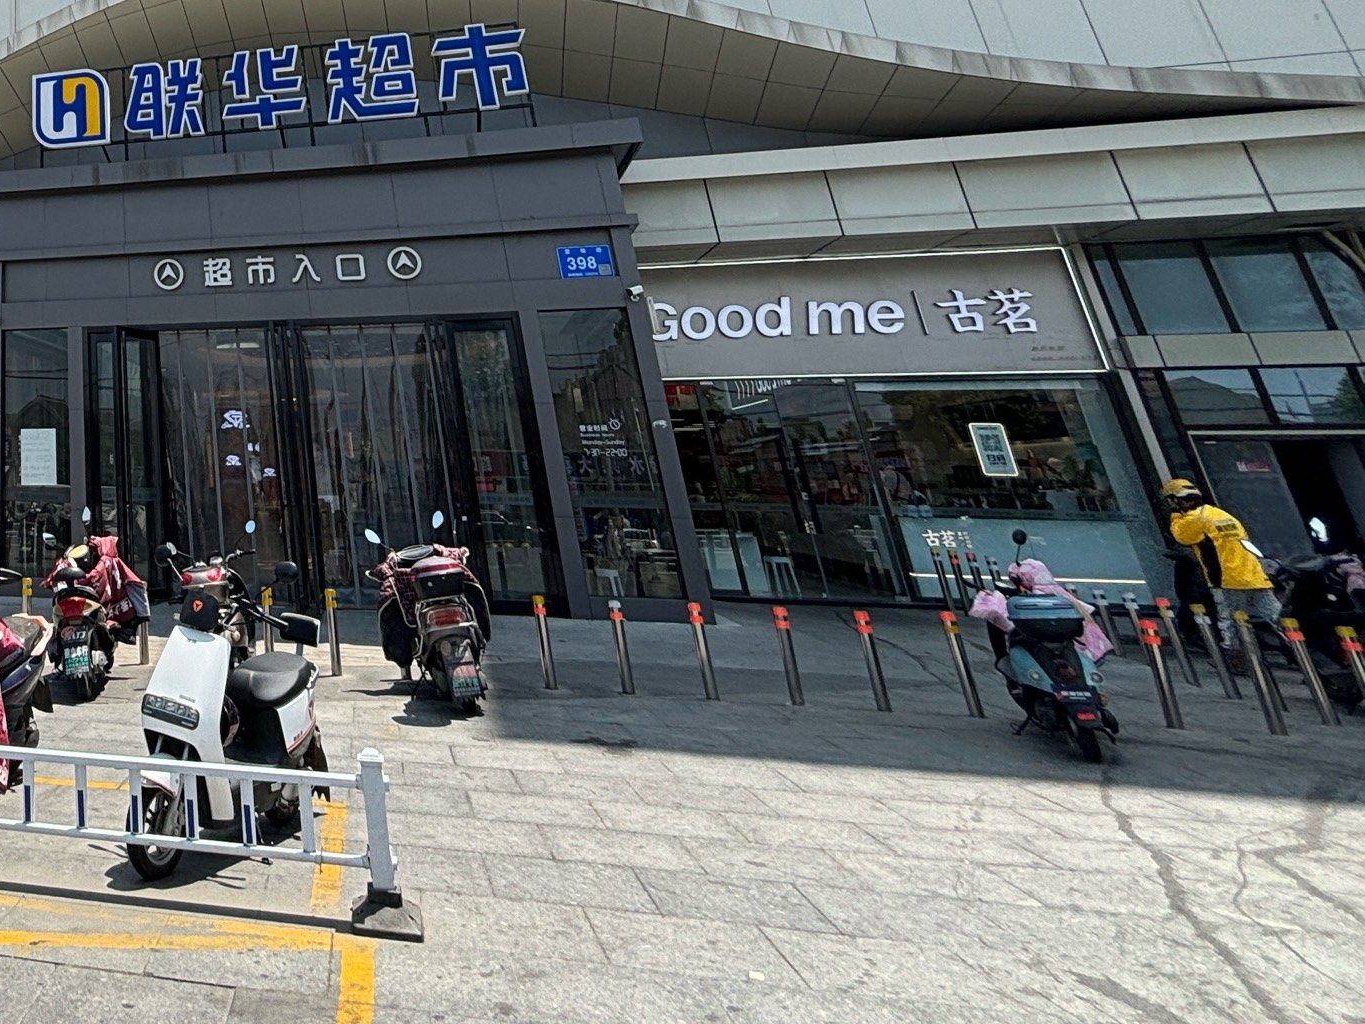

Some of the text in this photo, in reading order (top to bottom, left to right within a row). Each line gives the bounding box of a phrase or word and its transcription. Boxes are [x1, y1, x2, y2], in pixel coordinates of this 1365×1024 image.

[124, 23, 530, 140] 联华超市
[203, 254, 366, 287] 超市入口
[566, 256, 597, 270] 398
[652, 296, 906, 341] Good me
[935, 288, 1038, 335] 古茗
[922, 529, 957, 548] 古茗
